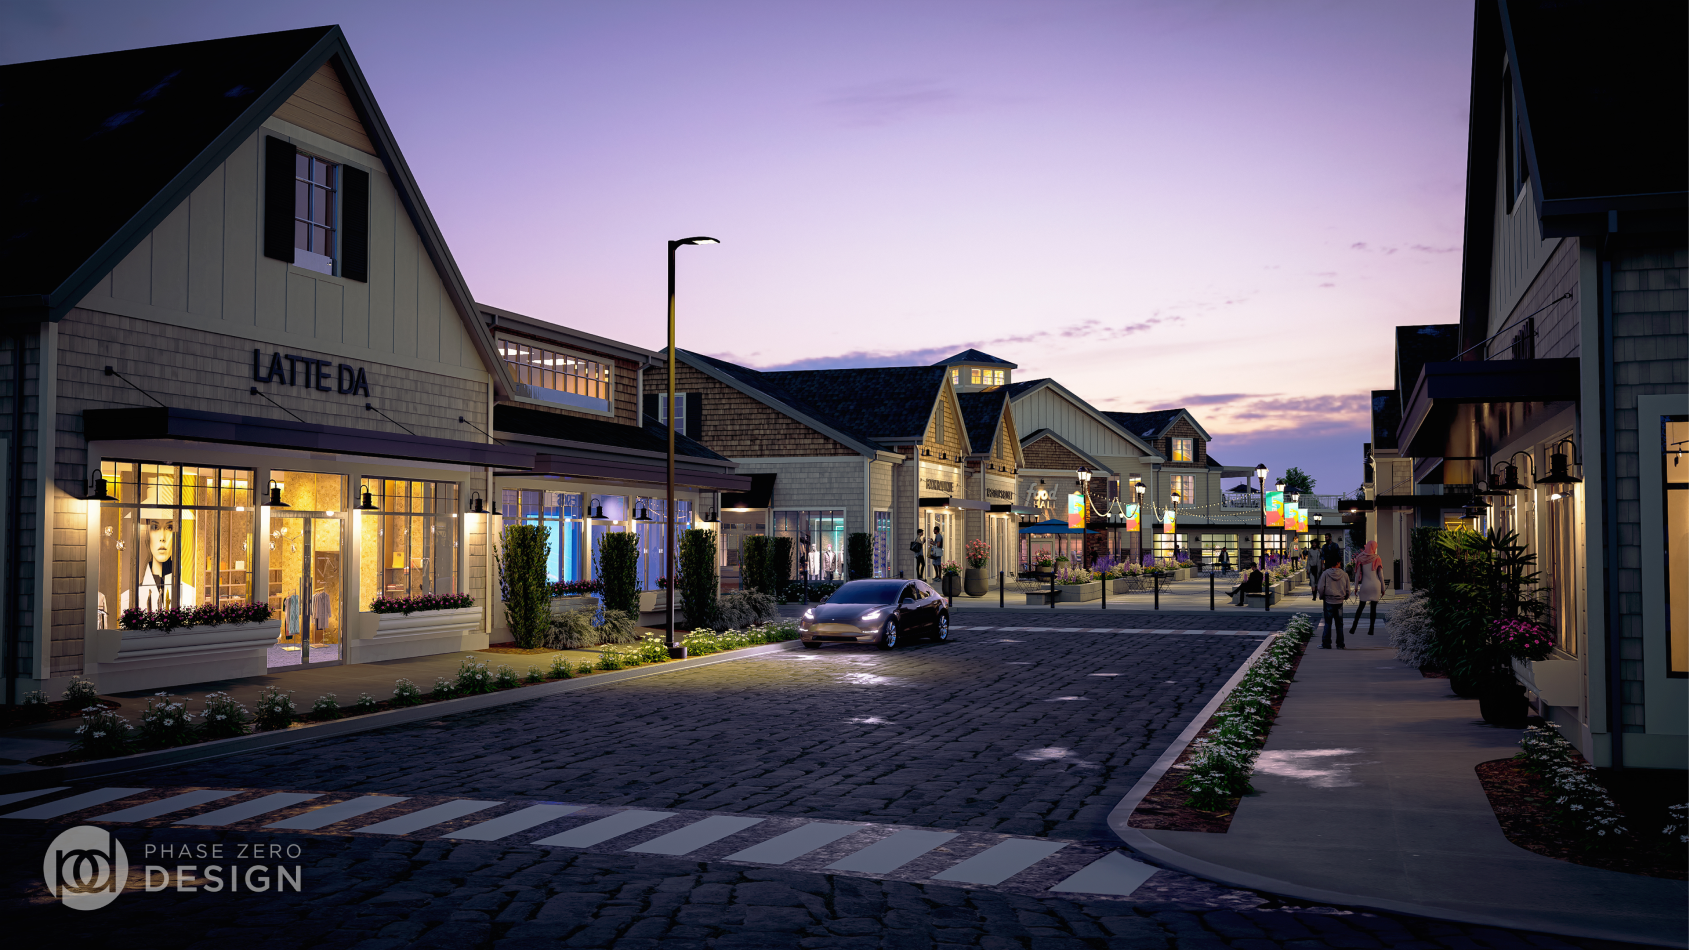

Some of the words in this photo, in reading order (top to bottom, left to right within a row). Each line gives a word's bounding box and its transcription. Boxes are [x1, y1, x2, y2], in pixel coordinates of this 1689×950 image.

[254, 349, 332, 391] LATTE
[338, 363, 370, 397] DA
[1024, 482, 1059, 507] food
[1033, 500, 1056, 509] HALL
